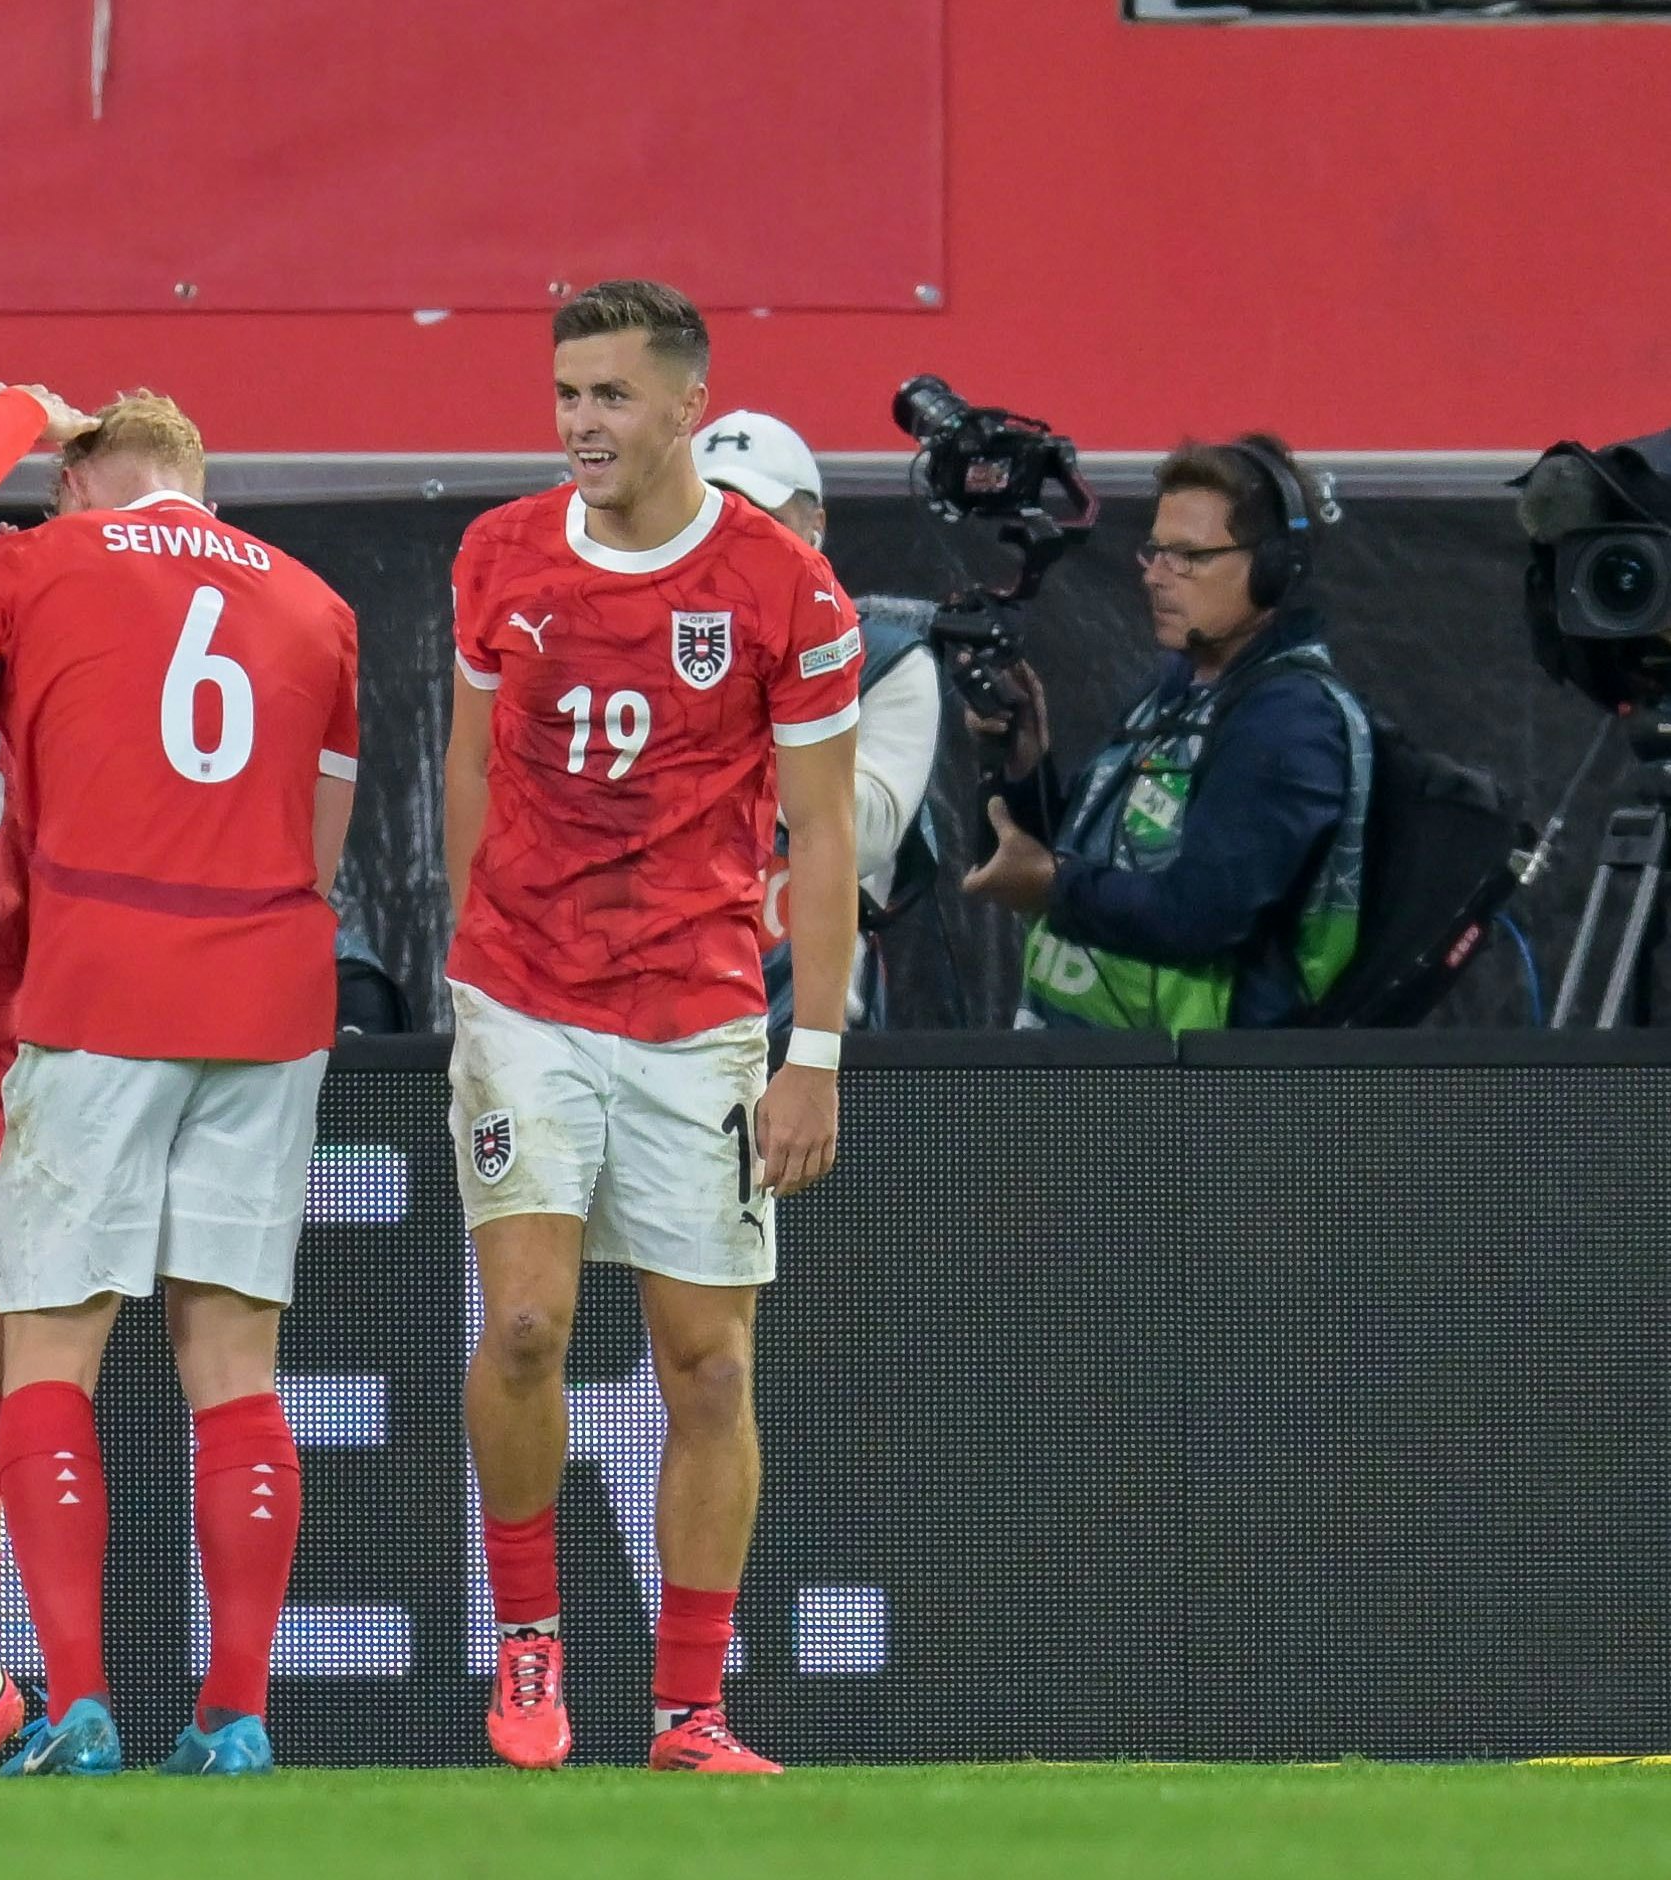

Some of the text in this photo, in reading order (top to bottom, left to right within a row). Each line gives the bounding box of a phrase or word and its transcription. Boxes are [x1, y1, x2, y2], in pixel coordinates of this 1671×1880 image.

[102, 523, 271, 571] SEIWALD
[161, 585, 254, 783] 6
[557, 686, 651, 780] 19
[721, 1102, 764, 1205] 1
